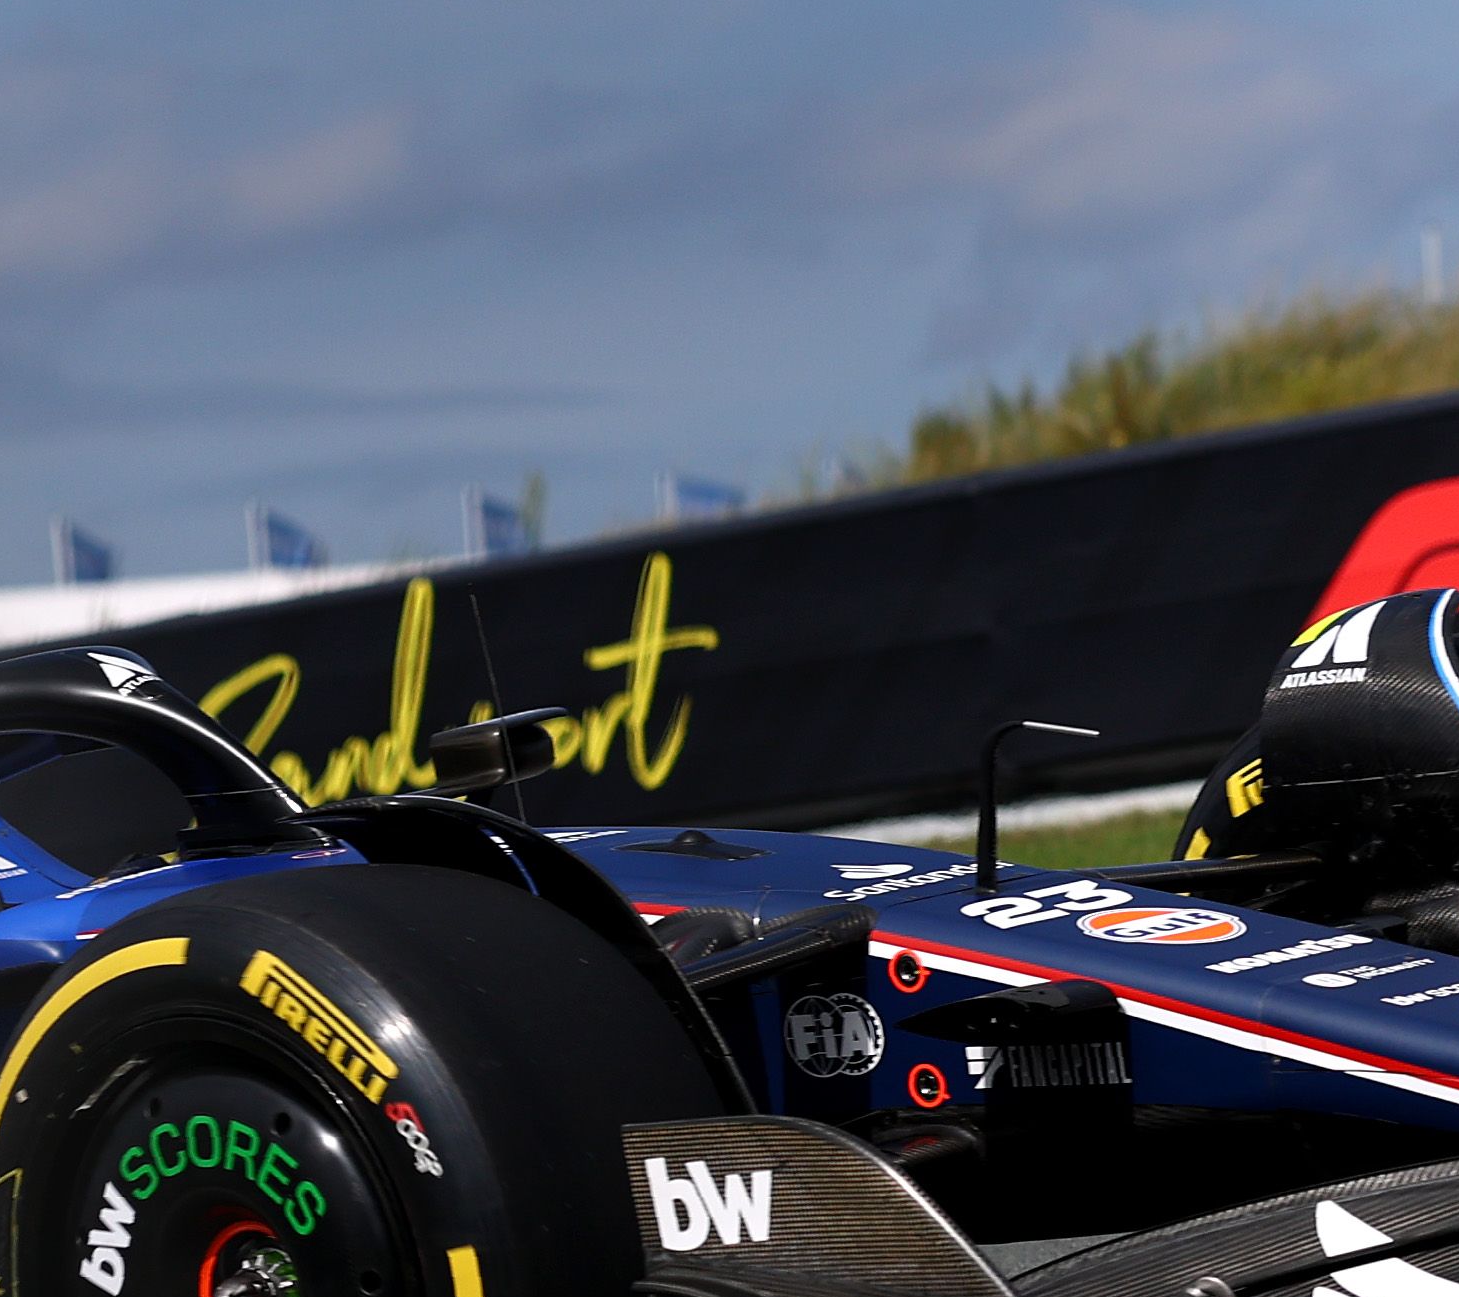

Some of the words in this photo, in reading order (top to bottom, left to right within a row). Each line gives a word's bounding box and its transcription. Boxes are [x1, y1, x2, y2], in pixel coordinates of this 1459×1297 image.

[1280, 667, 1367, 689] ATLASSIAN
[156, 552, 720, 864] Zandort
[822, 859, 1015, 902] Santandr
[960, 879, 1134, 930] 23
[1104, 912, 1220, 939] Gulf
[1204, 934, 1374, 974] KOMATSU
[238, 949, 401, 1105] PIRELLI
[79, 1181, 137, 1297] bw
[118, 1115, 328, 1236] SCORES
[644, 1157, 773, 1252] bw
